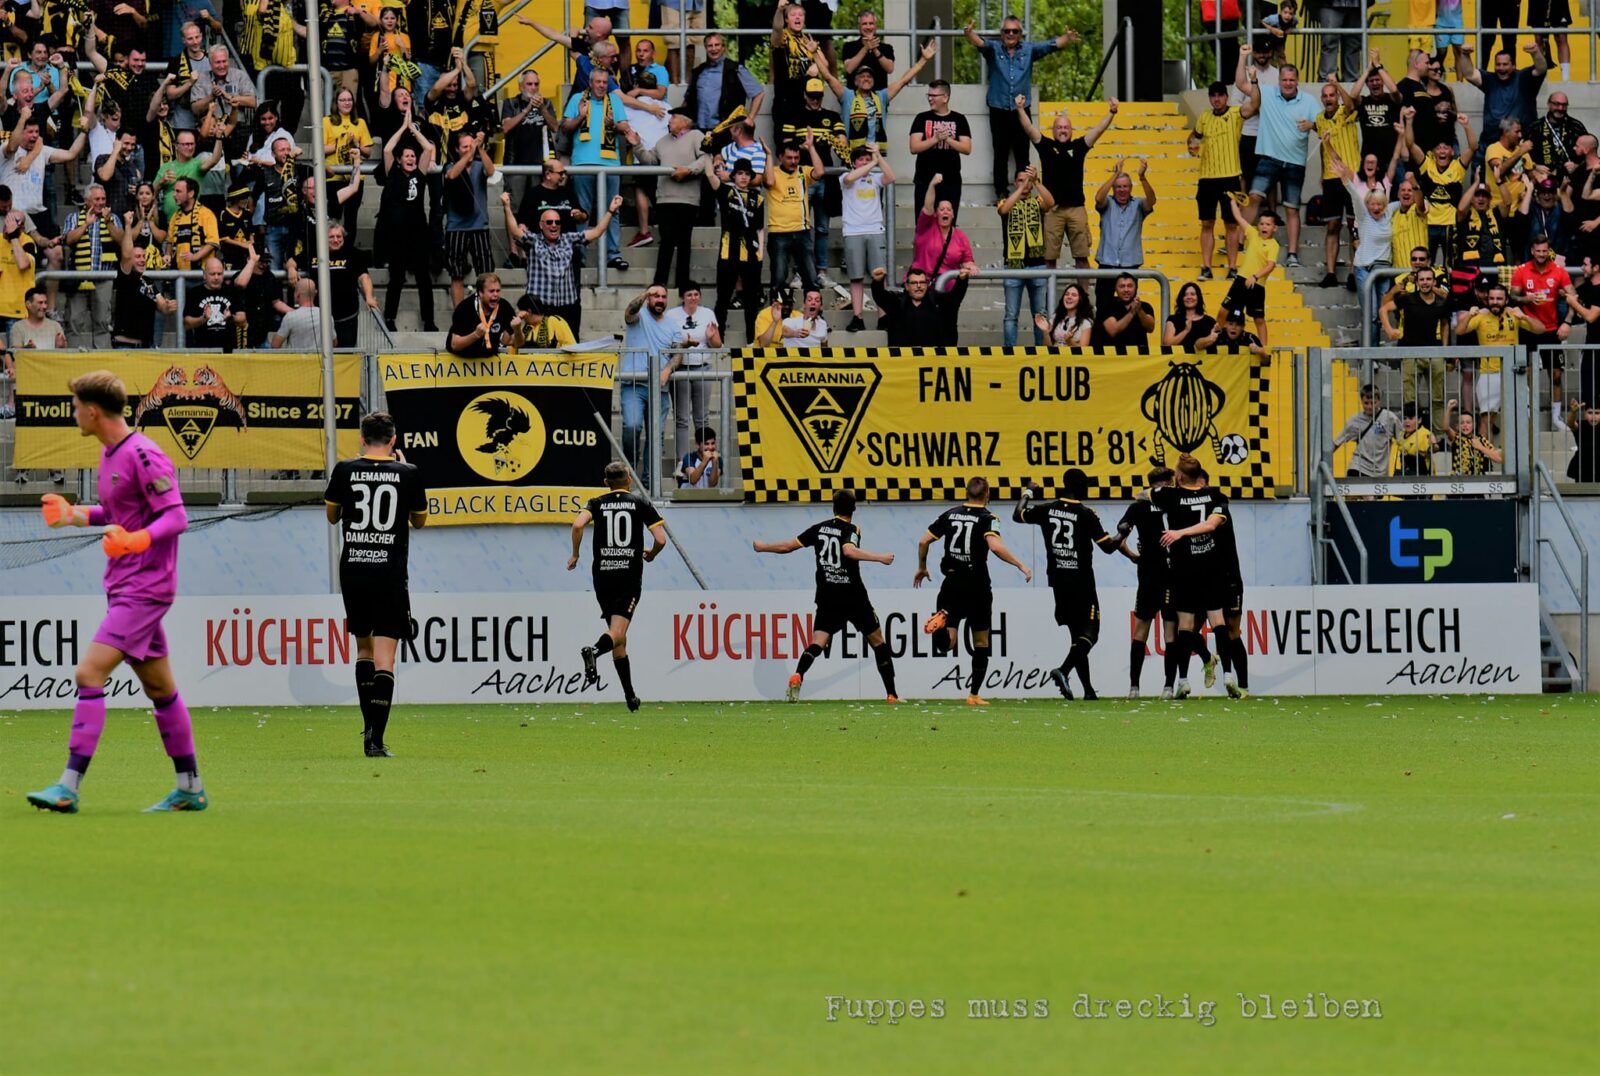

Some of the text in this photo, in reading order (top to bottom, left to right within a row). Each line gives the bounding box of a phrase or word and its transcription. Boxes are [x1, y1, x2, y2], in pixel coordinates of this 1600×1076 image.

[384, 360, 616, 381] ALEMANNIA AACHEN
[778, 371, 866, 385] ALEMANNIA
[918, 366, 972, 402] FAN
[1018, 366, 1091, 402] CLUB
[22, 401, 71, 418] Tivoli
[247, 402, 301, 419] Since
[168, 408, 214, 418] Alemannia
[403, 428, 598, 449] FAN CLUB
[350, 471, 401, 483] ALEMANNIA
[1374, 484, 1389, 495] S5
[1412, 484, 1427, 494] S5
[1450, 483, 1465, 494] S5
[1489, 482, 1503, 493] S5
[350, 483, 399, 532] 30
[428, 494, 581, 516] BLACK EAGLES
[600, 501, 636, 511] ALEMANNIA
[345, 531, 396, 545] DAMASCHEK
[602, 510, 632, 548] 10
[949, 520, 974, 554] 21
[1049, 517, 1075, 550] 23
[818, 534, 841, 569] 20
[470, 665, 609, 696] Aachen
[1386, 656, 1521, 687] Aachen
